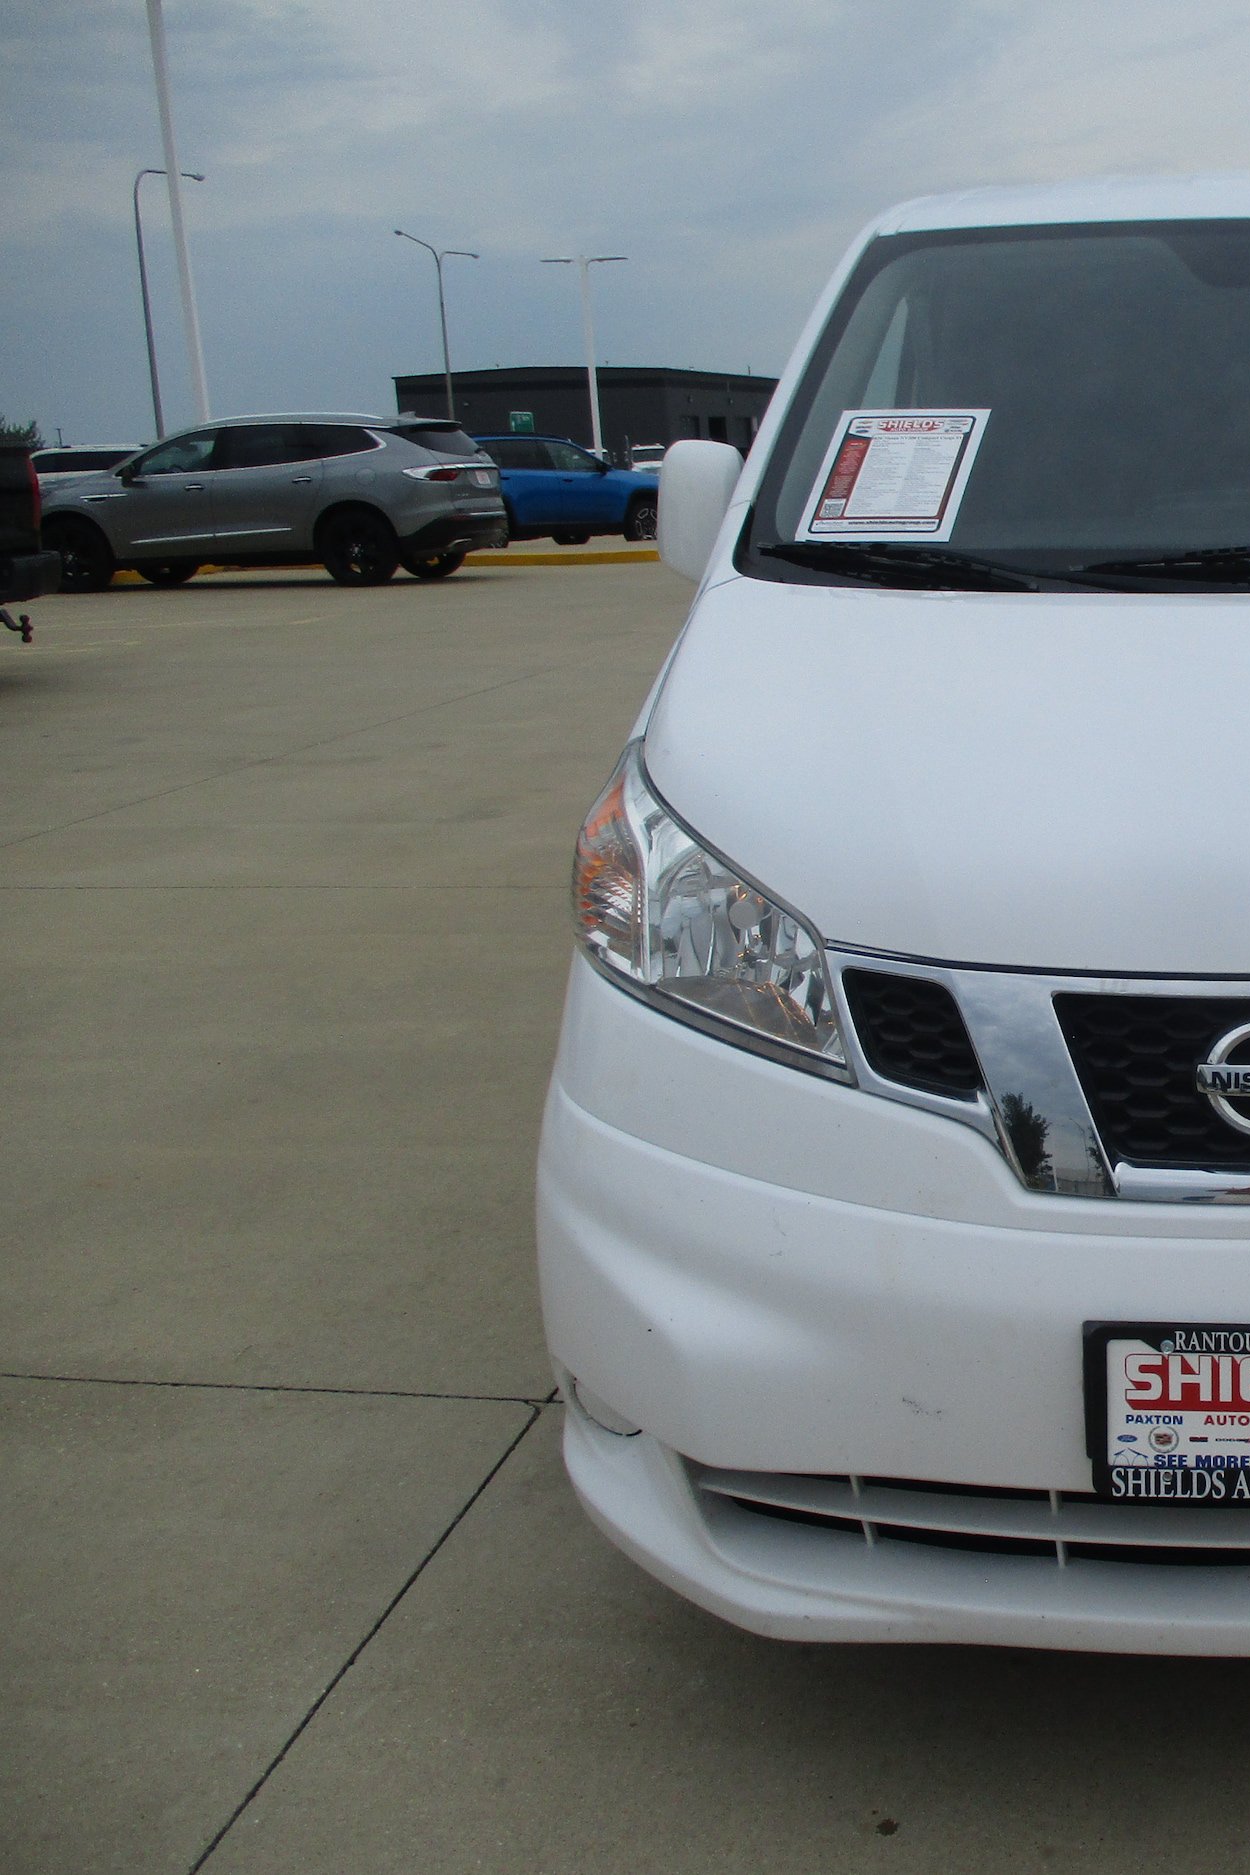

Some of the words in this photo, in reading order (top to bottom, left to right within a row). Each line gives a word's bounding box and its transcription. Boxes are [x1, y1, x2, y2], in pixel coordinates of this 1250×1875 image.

[877, 419, 945, 429] SHIELDS
[1125, 1414, 1183, 1425] PAXTON
[1203, 1415, 1250, 1426] AUTO
[1153, 1455, 1188, 1468] SEE
[1195, 1455, 1250, 1468] MORE
[1111, 1468, 1226, 1499] SHIELDS
